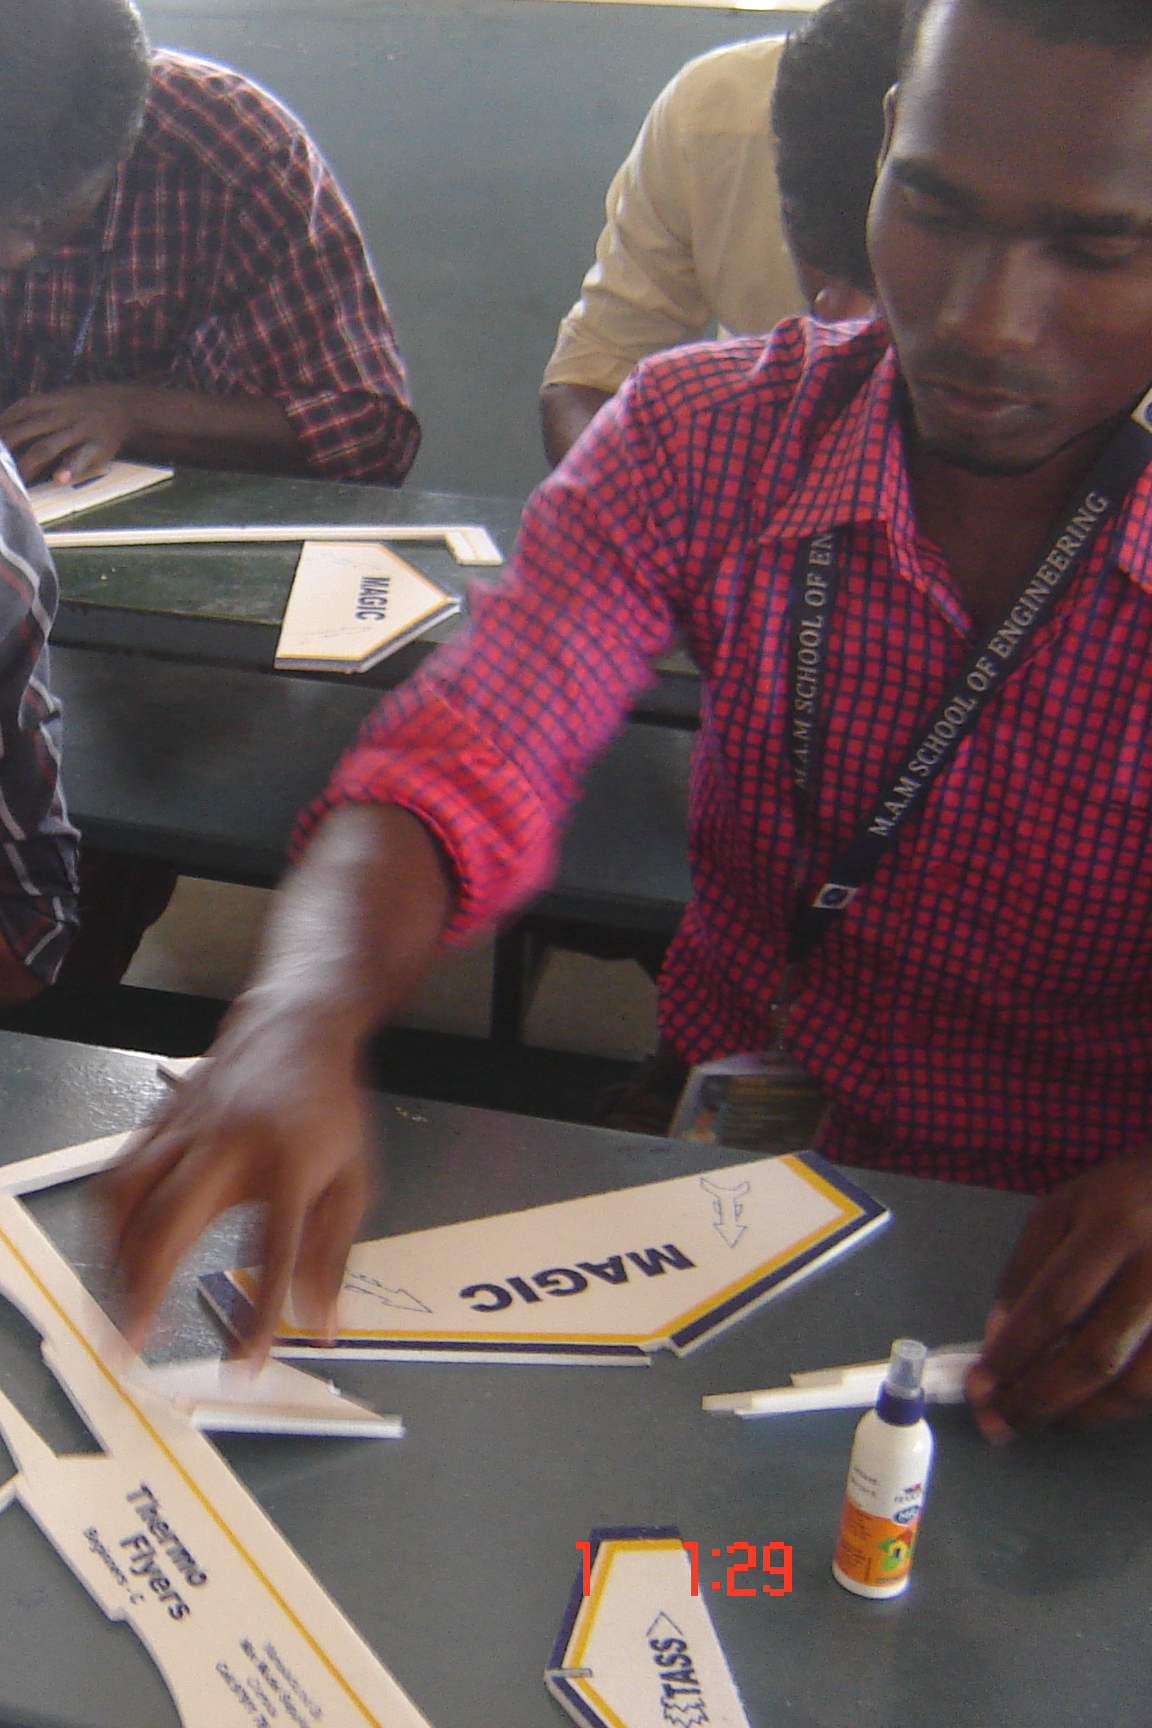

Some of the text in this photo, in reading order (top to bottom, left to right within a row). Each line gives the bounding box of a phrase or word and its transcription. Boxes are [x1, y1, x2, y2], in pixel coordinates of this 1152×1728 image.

[354, 576, 390, 622] MAGIC
[804, 571, 830, 608] OF
[794, 614, 823, 714] SCHOOL
[908, 696, 979, 777] SCHOOL
[966, 655, 998, 694] OF
[987, 490, 1110, 661] ENGINEERING
[457, 1243, 697, 1314] MAGIC
[125, 1483, 207, 1588] Thermo
[119, 1534, 190, 1621] Flyers
[648, 1637, 704, 1700] TASS
